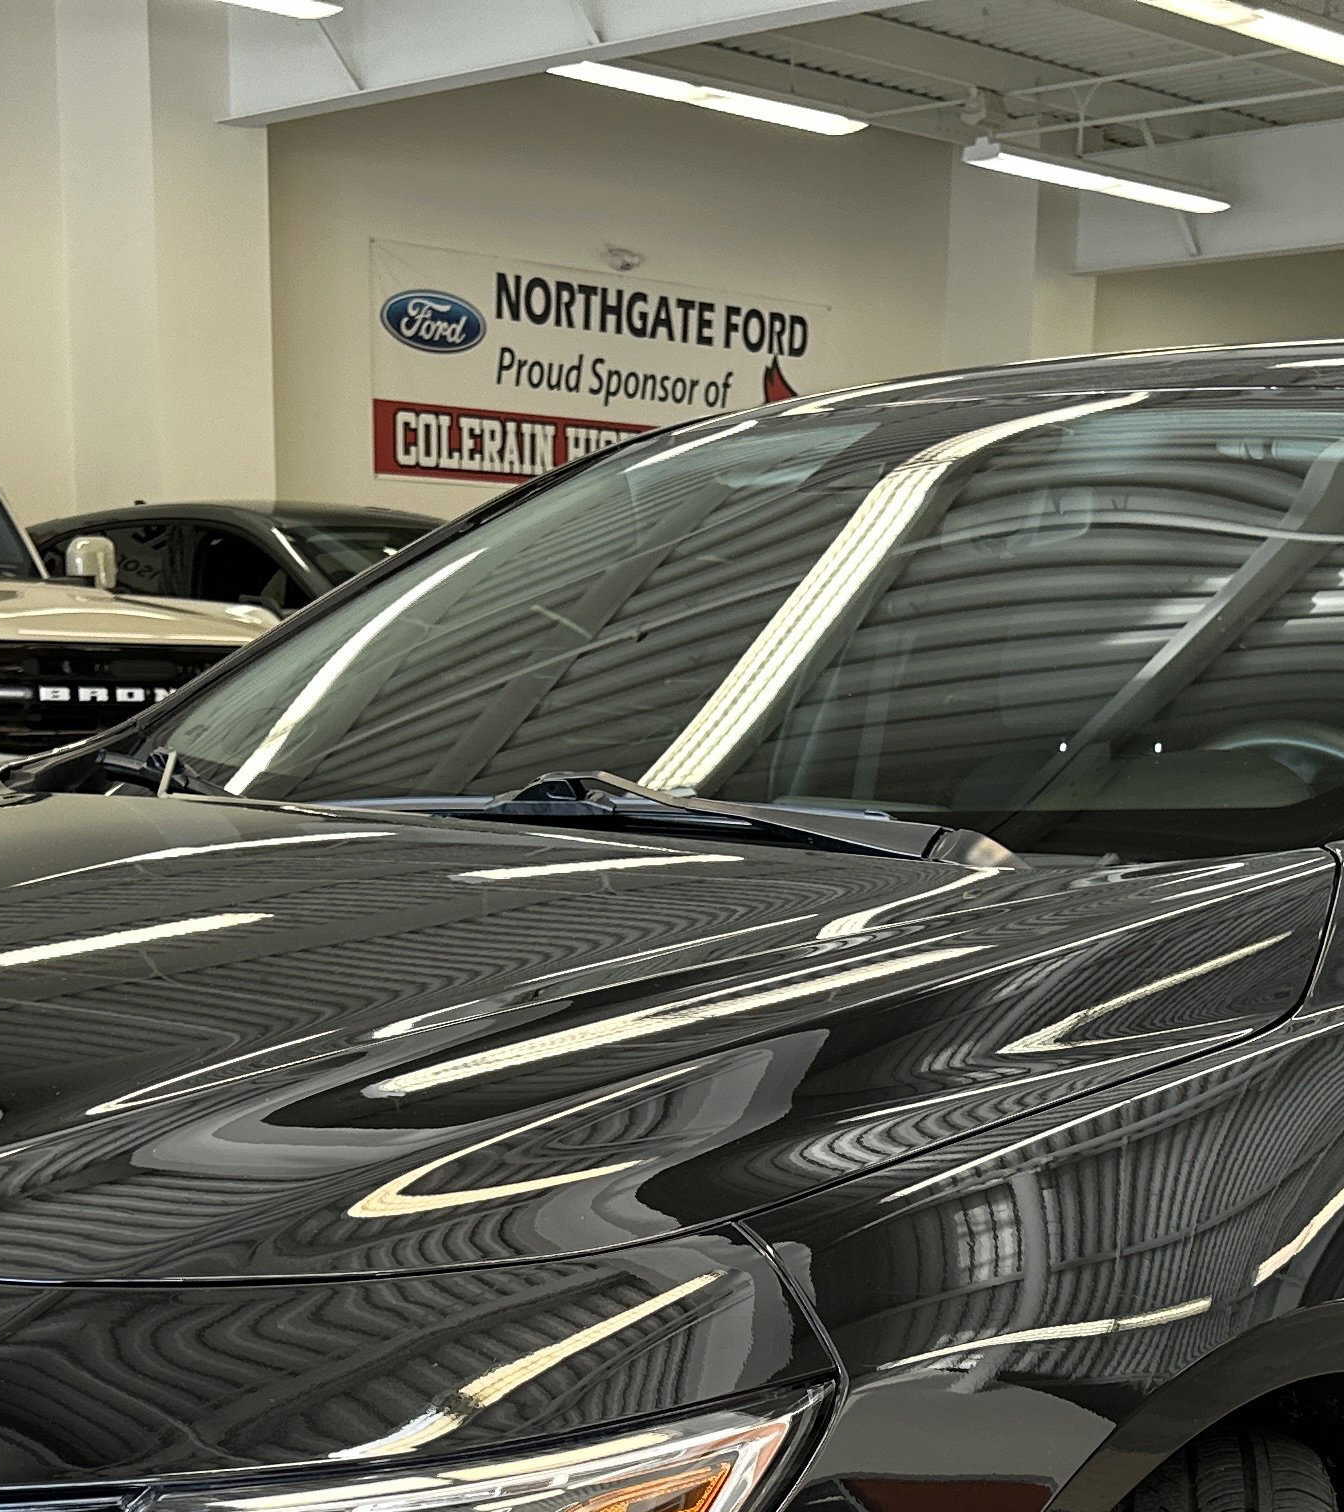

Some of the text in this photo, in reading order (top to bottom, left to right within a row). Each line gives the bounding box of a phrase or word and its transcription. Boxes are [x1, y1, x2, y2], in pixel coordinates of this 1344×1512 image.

[399, 296, 468, 345] Ford
[495, 273, 808, 358] NORTHGATE FORD
[496, 347, 734, 409] Proud Sponsor of
[395, 410, 557, 476] COLERAIN
